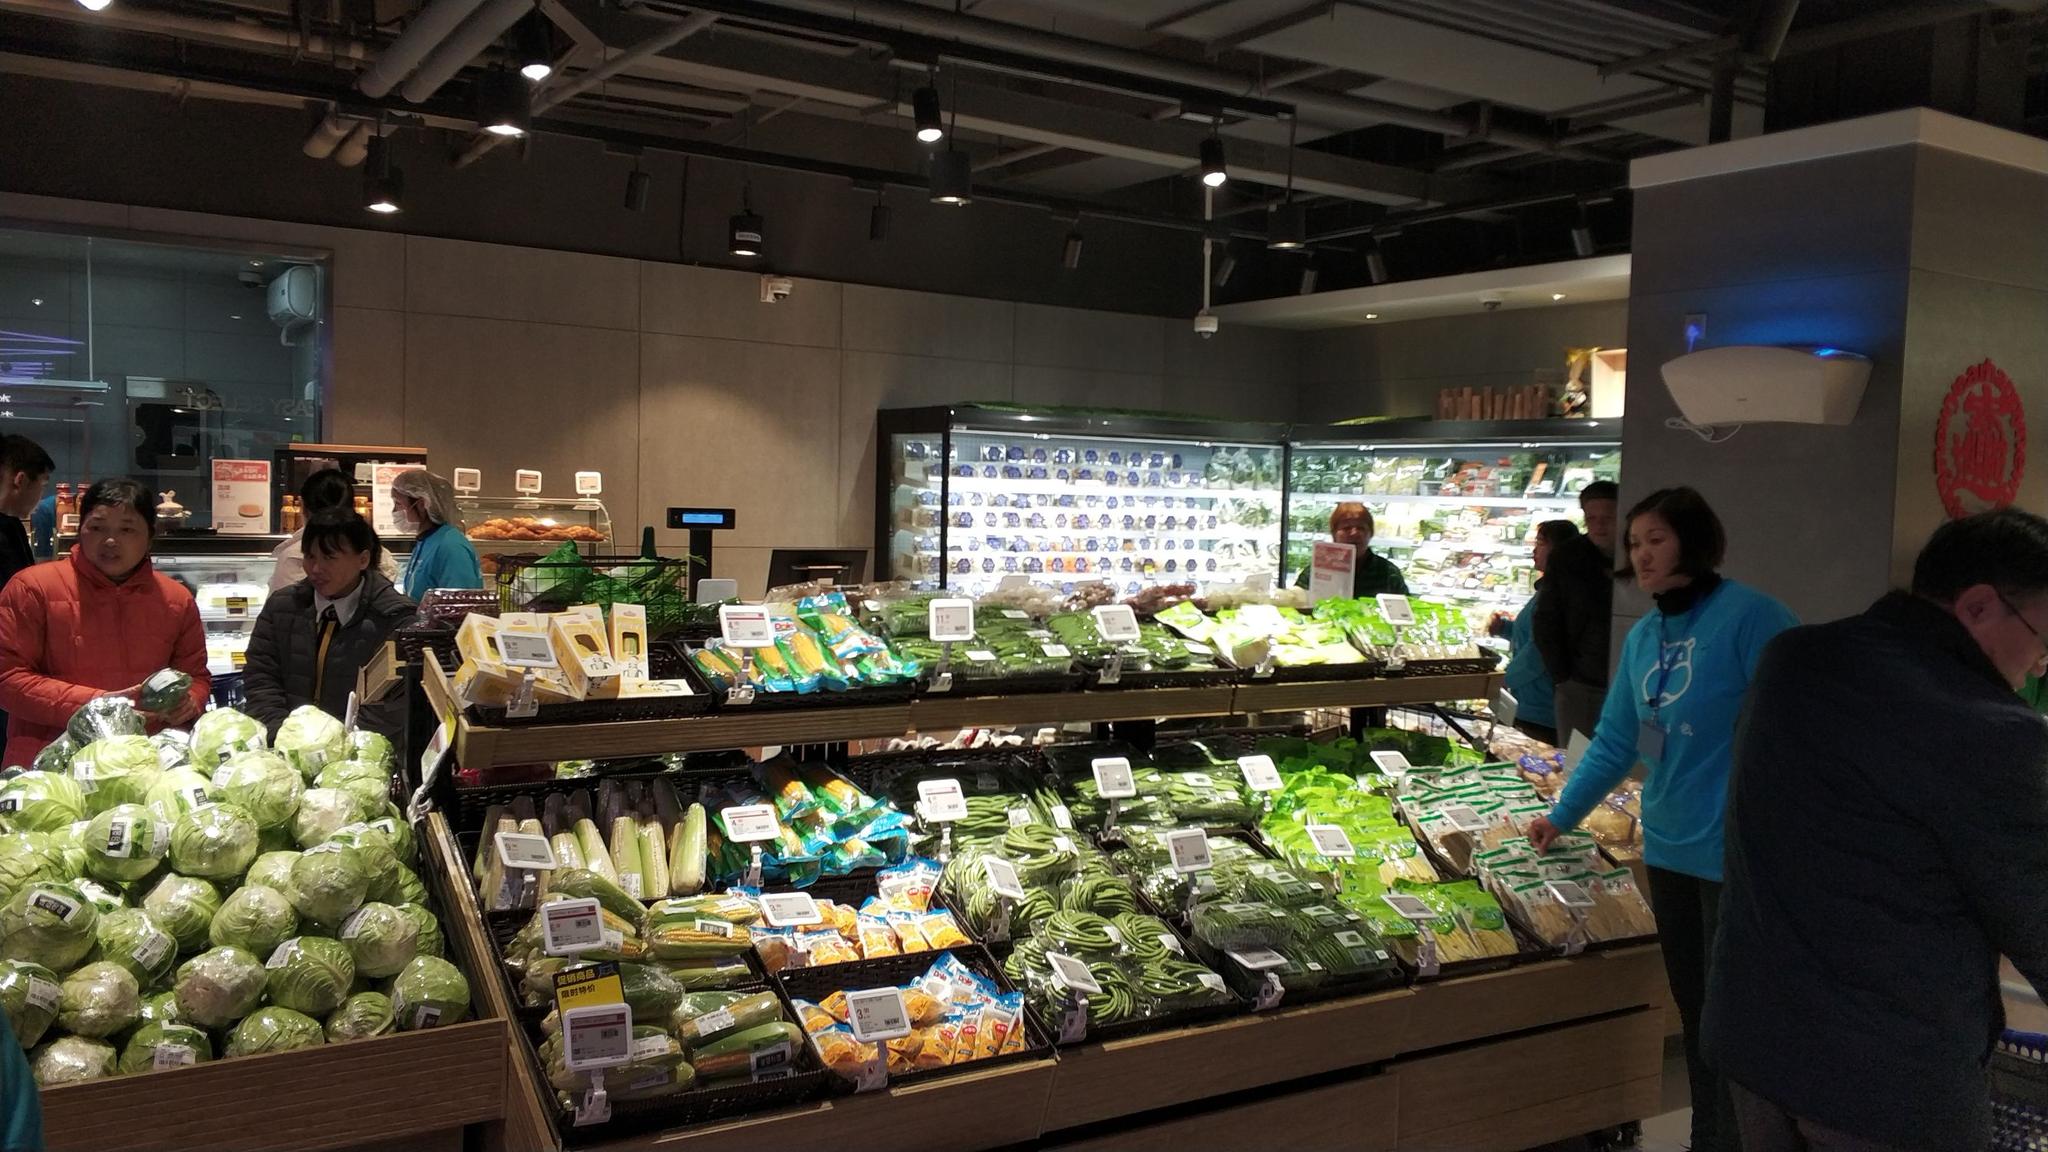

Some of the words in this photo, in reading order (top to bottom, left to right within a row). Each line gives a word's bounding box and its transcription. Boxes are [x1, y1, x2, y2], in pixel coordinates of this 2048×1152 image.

[558, 969, 595, 985] 促销商品
[933, 970, 949, 982] Dole
[957, 974, 974, 987] Dole
[561, 984, 596, 998] 限时特价
[976, 994, 993, 1005] Dole
